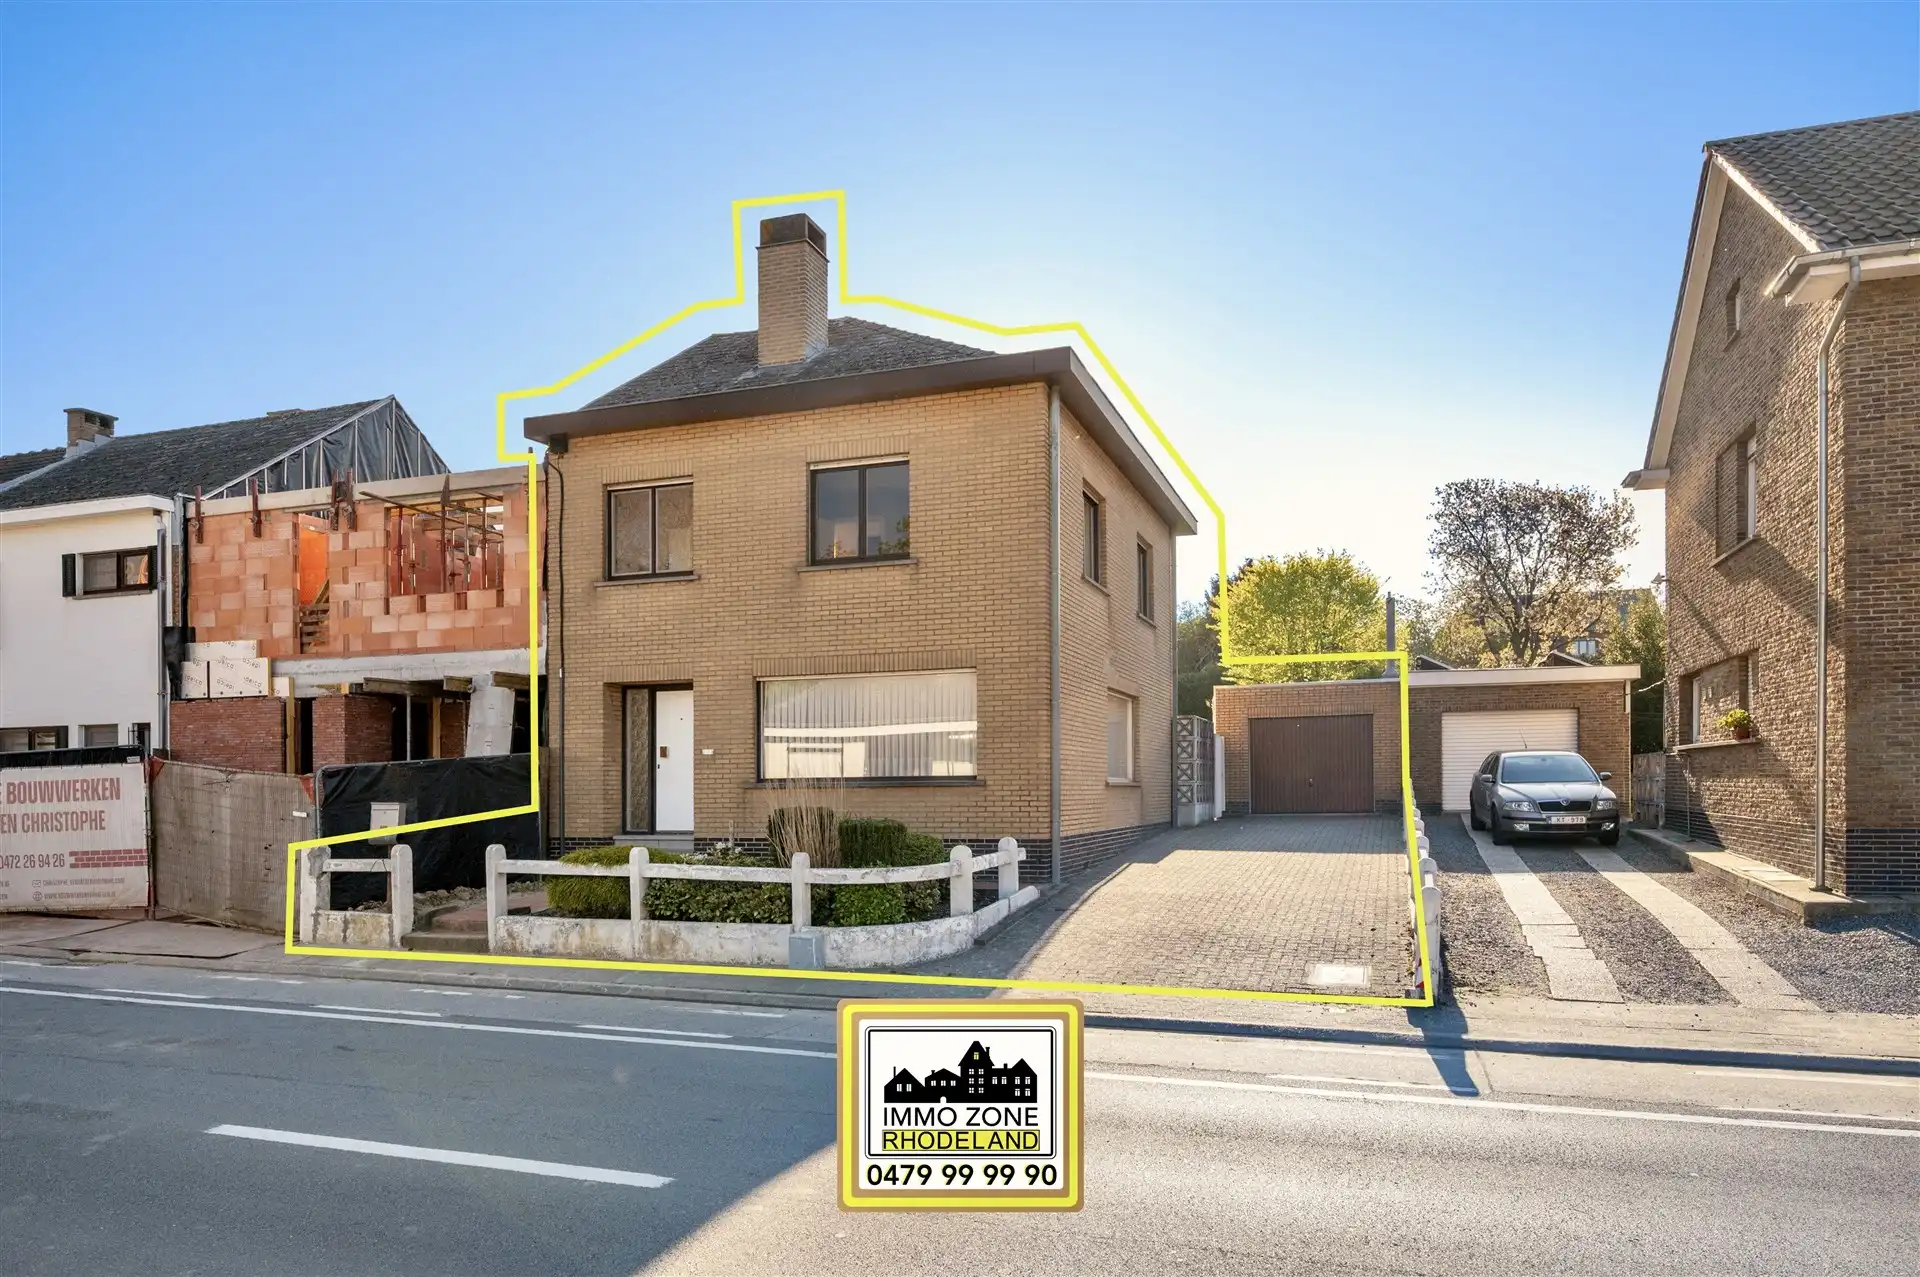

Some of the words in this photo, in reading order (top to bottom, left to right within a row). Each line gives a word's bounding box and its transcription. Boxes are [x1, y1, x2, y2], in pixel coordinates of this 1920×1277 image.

[6, 777, 121, 804] BOUWWERKEN
[21, 810, 106, 833] CHRISTOPHE
[23, 854, 36, 869] 26
[38, 853, 51, 868] 94
[52, 853, 65, 868] 26
